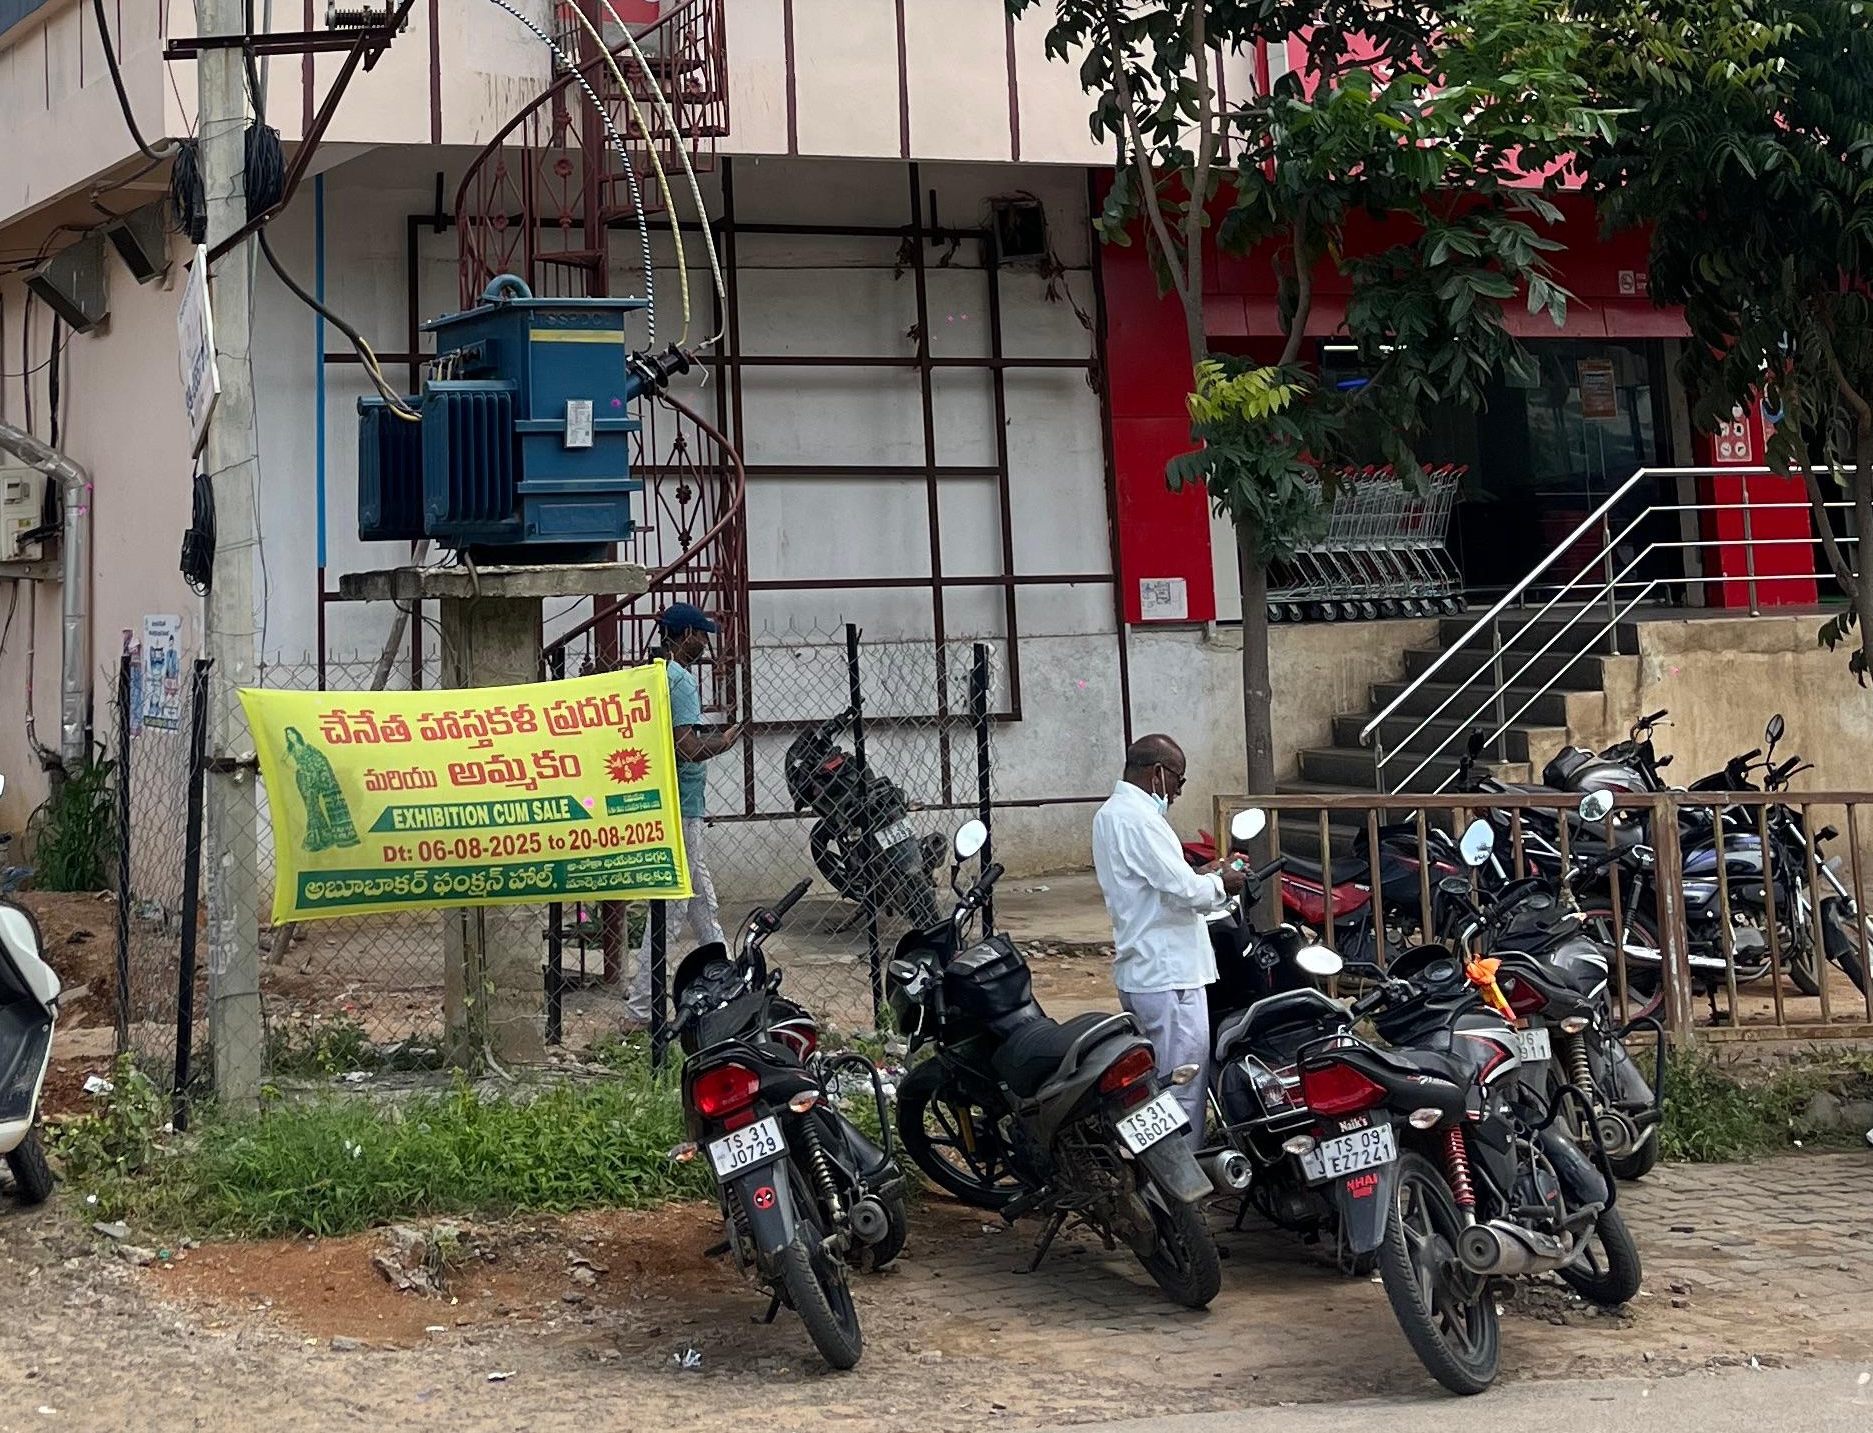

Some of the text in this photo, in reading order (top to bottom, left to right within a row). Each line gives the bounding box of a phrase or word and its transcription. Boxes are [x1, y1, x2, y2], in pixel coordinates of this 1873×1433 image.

[318, 709, 412, 745] చేనేత
[543, 688, 651, 739] ప్రదర్శన
[362, 766, 438, 792] మరియు
[448, 749, 582, 792] అమ్మకం
[392, 799, 571, 830] EXHIBITION CUM SALE
[382, 820, 665, 863] Dt: 06-08-2025 to 20-08-2025
[304, 874, 429, 901] అబూబాకర్
[432, 869, 504, 899] ఫంక్షన్
[1127, 1101, 1166, 1131] TS 31
[1134, 1112, 1178, 1146] B6021
[723, 1122, 768, 1153] TS 31
[730, 1136, 777, 1168] J0729
[1334, 1130, 1380, 1155] TS 09
[1332, 1143, 1390, 1173] EZ7241
